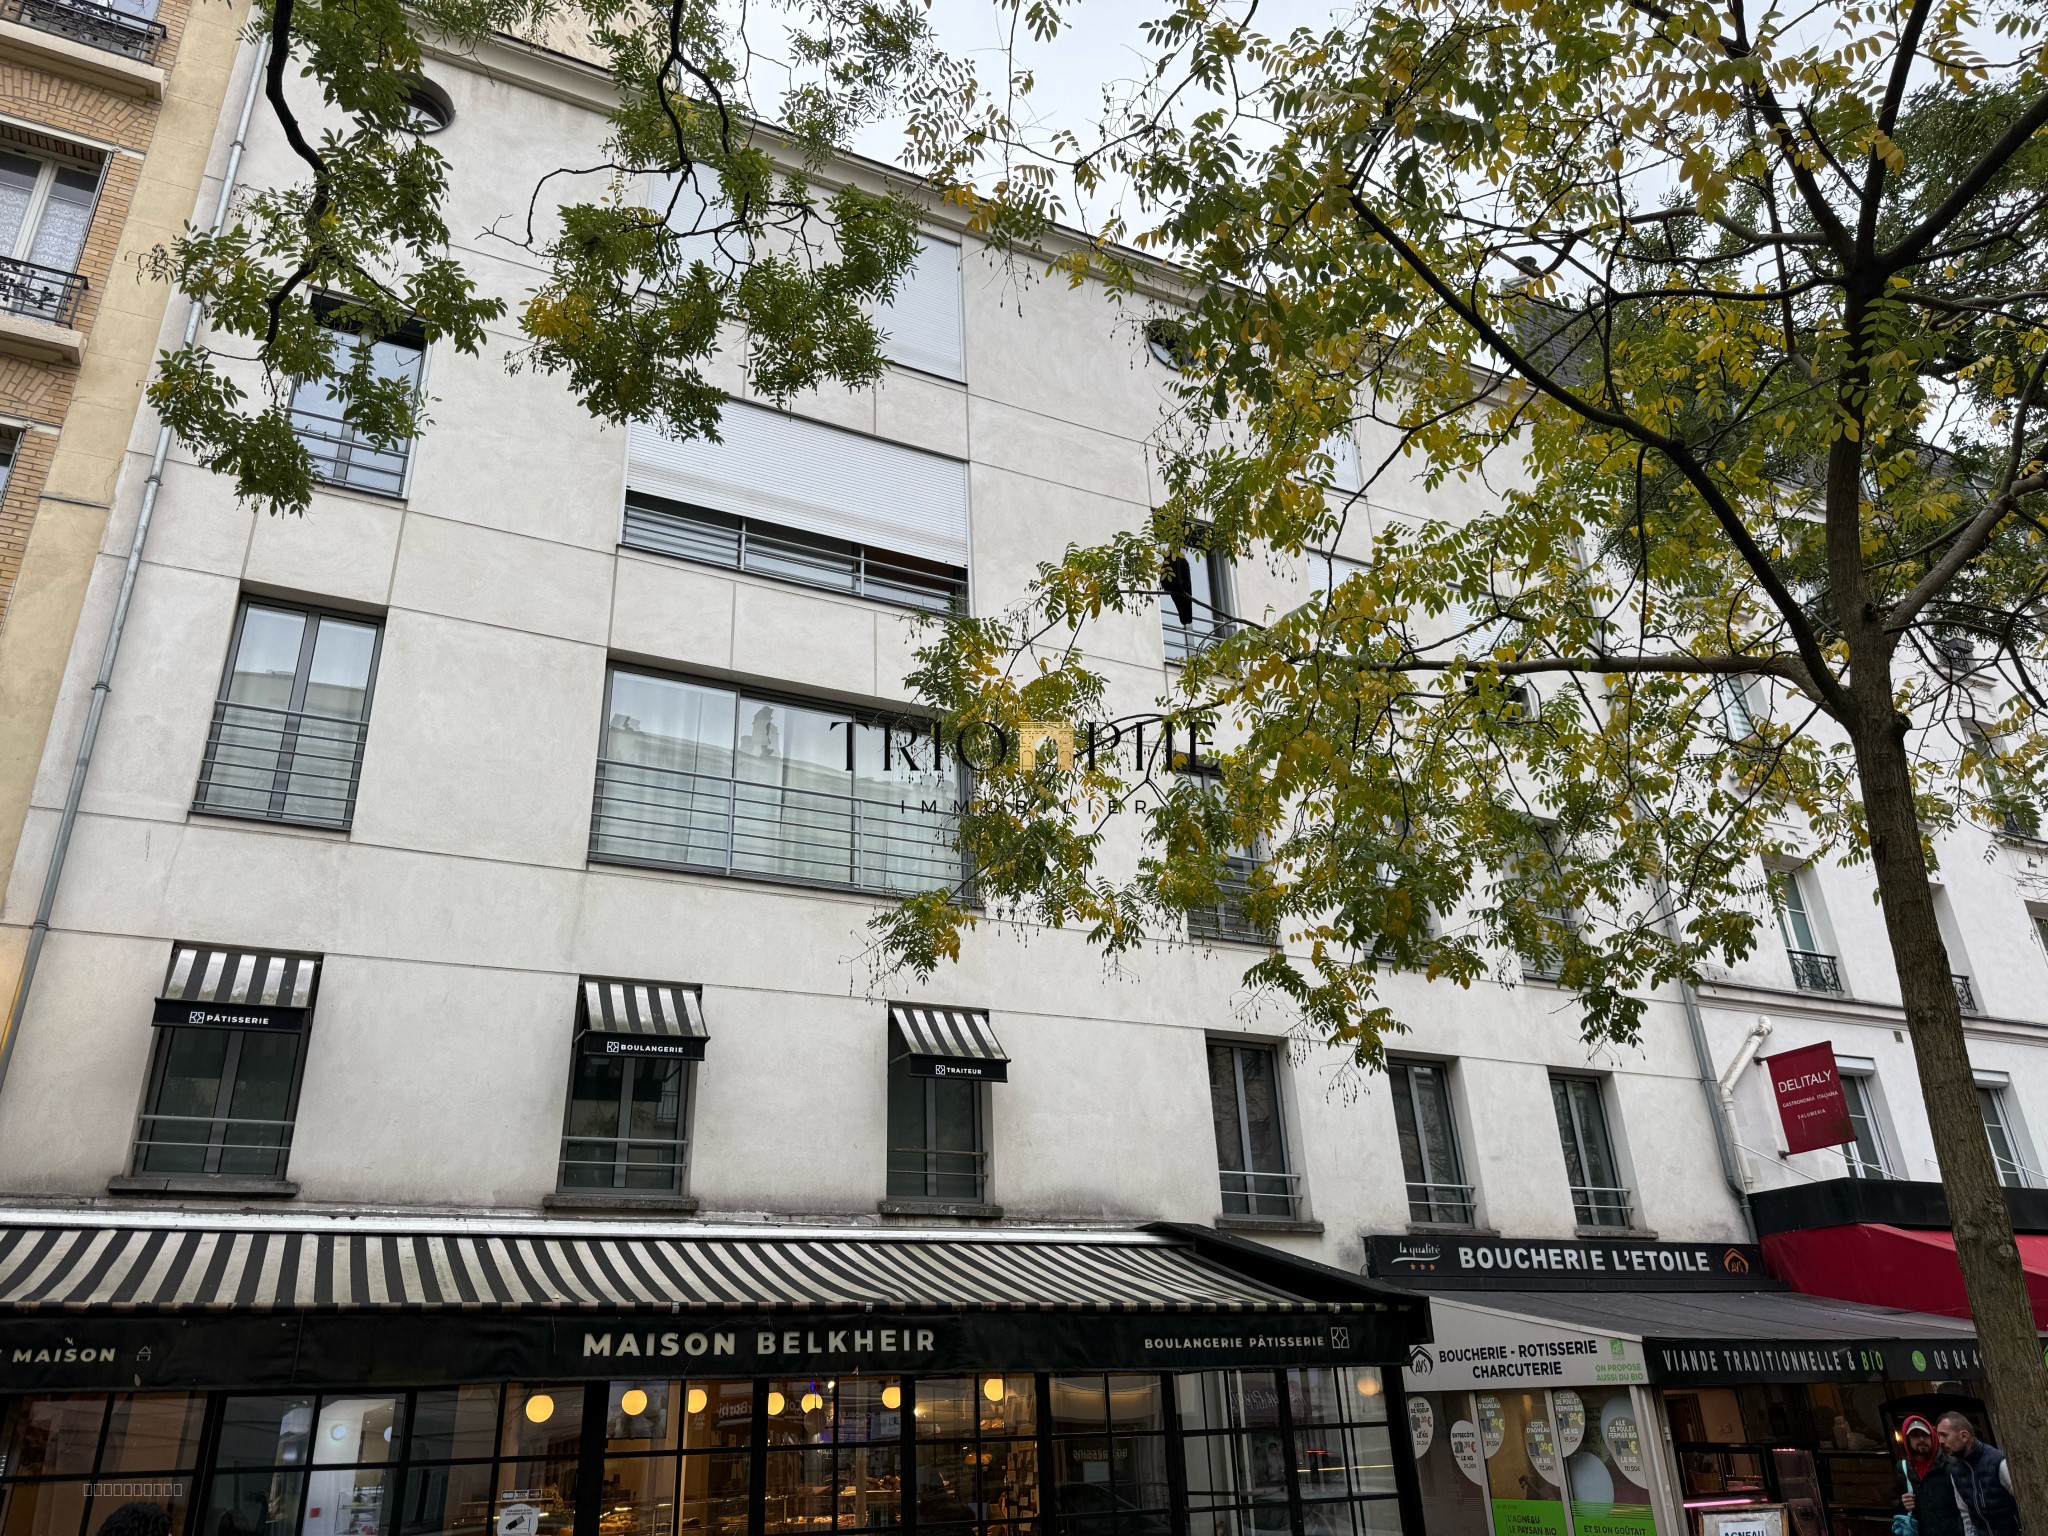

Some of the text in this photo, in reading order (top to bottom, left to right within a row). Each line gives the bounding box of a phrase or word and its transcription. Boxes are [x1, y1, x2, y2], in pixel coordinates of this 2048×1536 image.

[206, 1014, 270, 1025] PÂTISSERIE
[620, 1044, 684, 1054] BOULANGERIE
[946, 1067, 982, 1075] TRAITEUR
[1778, 1069, 1831, 1093] DELITALY
[1399, 1241, 1440, 1258] la qualité
[1458, 1246, 1711, 1272] BOUCHERIE L'ETOILE
[583, 1329, 935, 1358] MAISON BELKHEIR
[1144, 1334, 1325, 1349] BOULANGERIE PÂTISSERIE
[12, 1348, 116, 1363] MAISON
[1439, 1345, 1508, 1363] BOUCHERIE
[1518, 1340, 1598, 1358] ROTISSERIE
[1607, 1363, 1642, 1372] PROPOSE
[1663, 1350, 1884, 1372] VIANDE TRADITIONNELLE & BIO
[1933, 1350, 1949, 1370] 09
[1952, 1350, 1968, 1370] 84
[1472, 1361, 1563, 1379] CHARCUTERIE
[1597, 1373, 1644, 1382] AUSSI DU BIO
[1507, 1514, 1540, 1524] L'AGNEAU
[1509, 1524, 1557, 1536] LE PAYSAN BIO
[1584, 1525, 1646, 1535] ET SI ON GOÛTAIT
